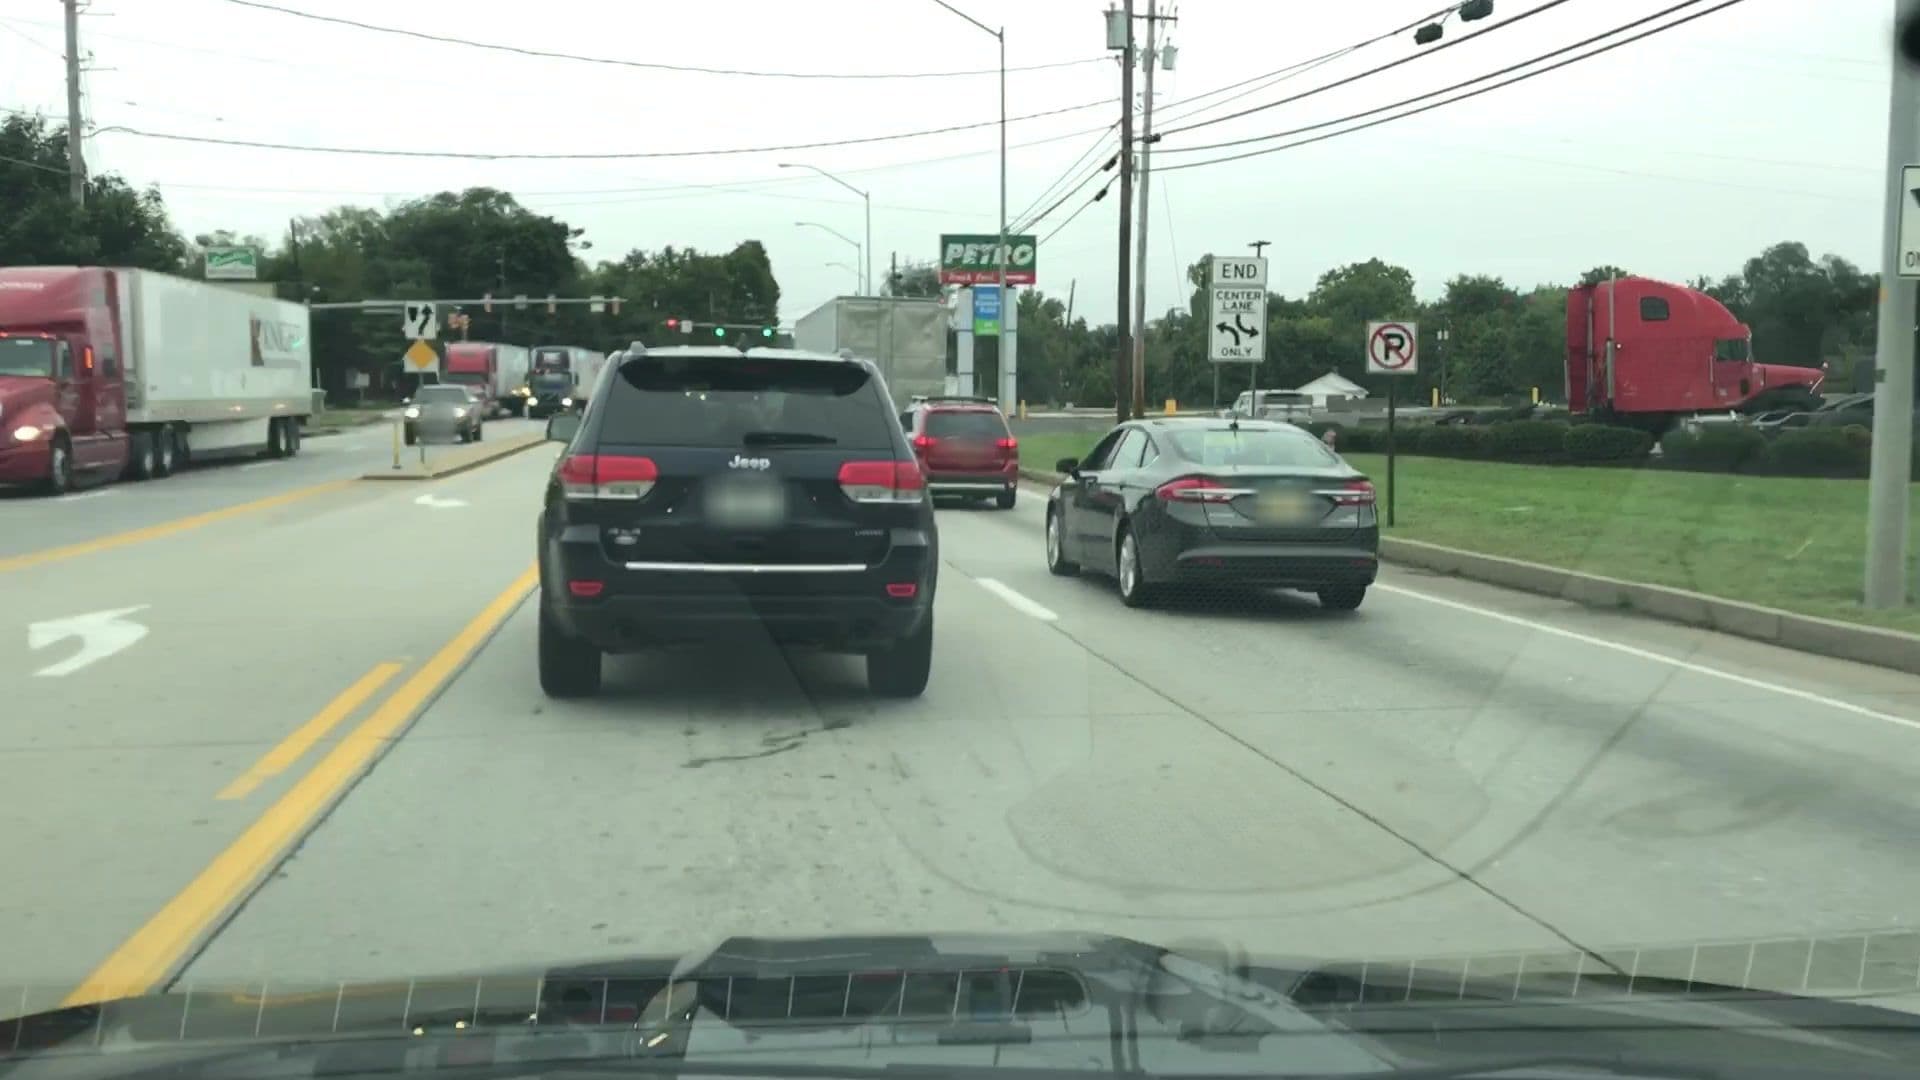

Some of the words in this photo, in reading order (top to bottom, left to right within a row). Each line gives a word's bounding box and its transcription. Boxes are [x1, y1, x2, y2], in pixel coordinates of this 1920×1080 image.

[943, 243, 1034, 266] PETRO
[1222, 263, 1258, 279] END
[1216, 291, 1262, 300] CENTER
[1222, 301, 1253, 311] LANE
[1221, 347, 1253, 357] ONLY
[728, 454, 771, 471] Jeep
